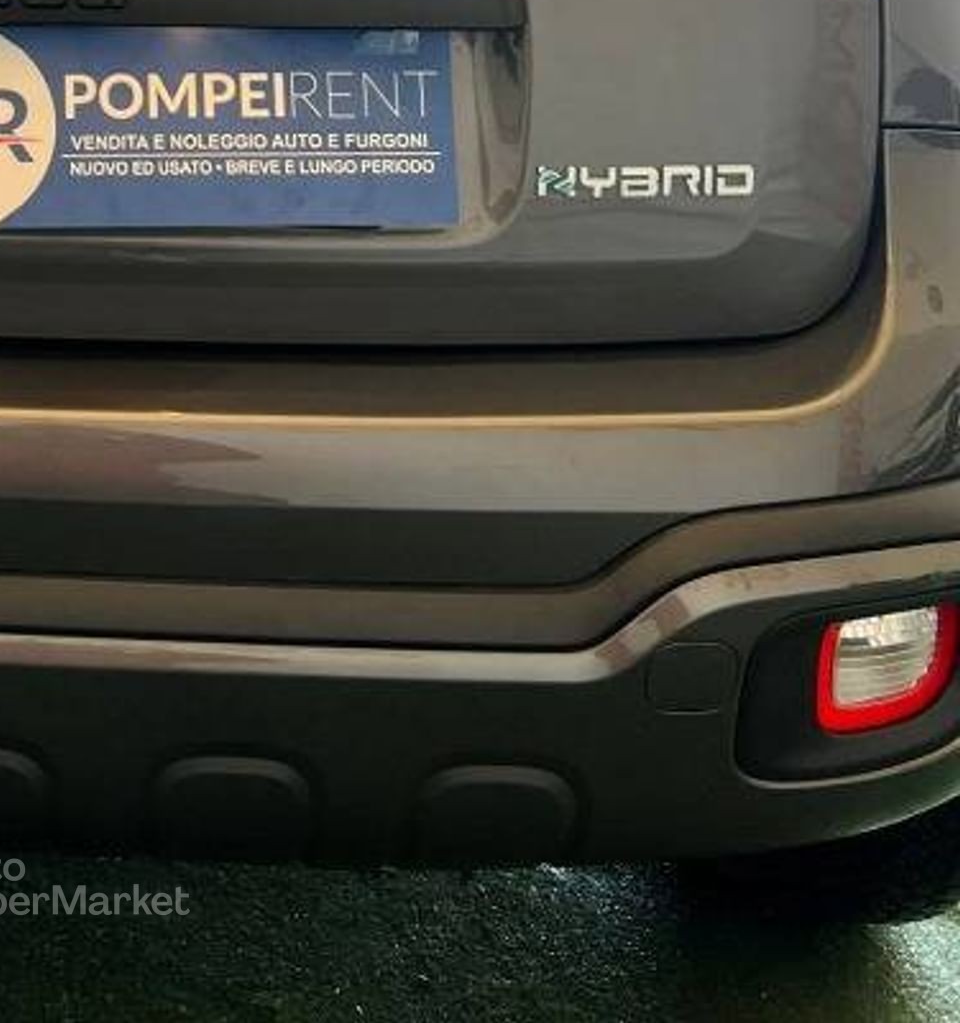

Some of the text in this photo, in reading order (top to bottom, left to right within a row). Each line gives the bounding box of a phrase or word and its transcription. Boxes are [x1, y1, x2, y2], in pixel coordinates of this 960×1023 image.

[71, 133, 428, 151] VENDITA E NOLEGGIO AUTO E FURGONI
[69, 159, 435, 177] NUOVO ED USATO BREVE E LUNGO PERIODO
[537, 164, 755, 198] HYBRID
